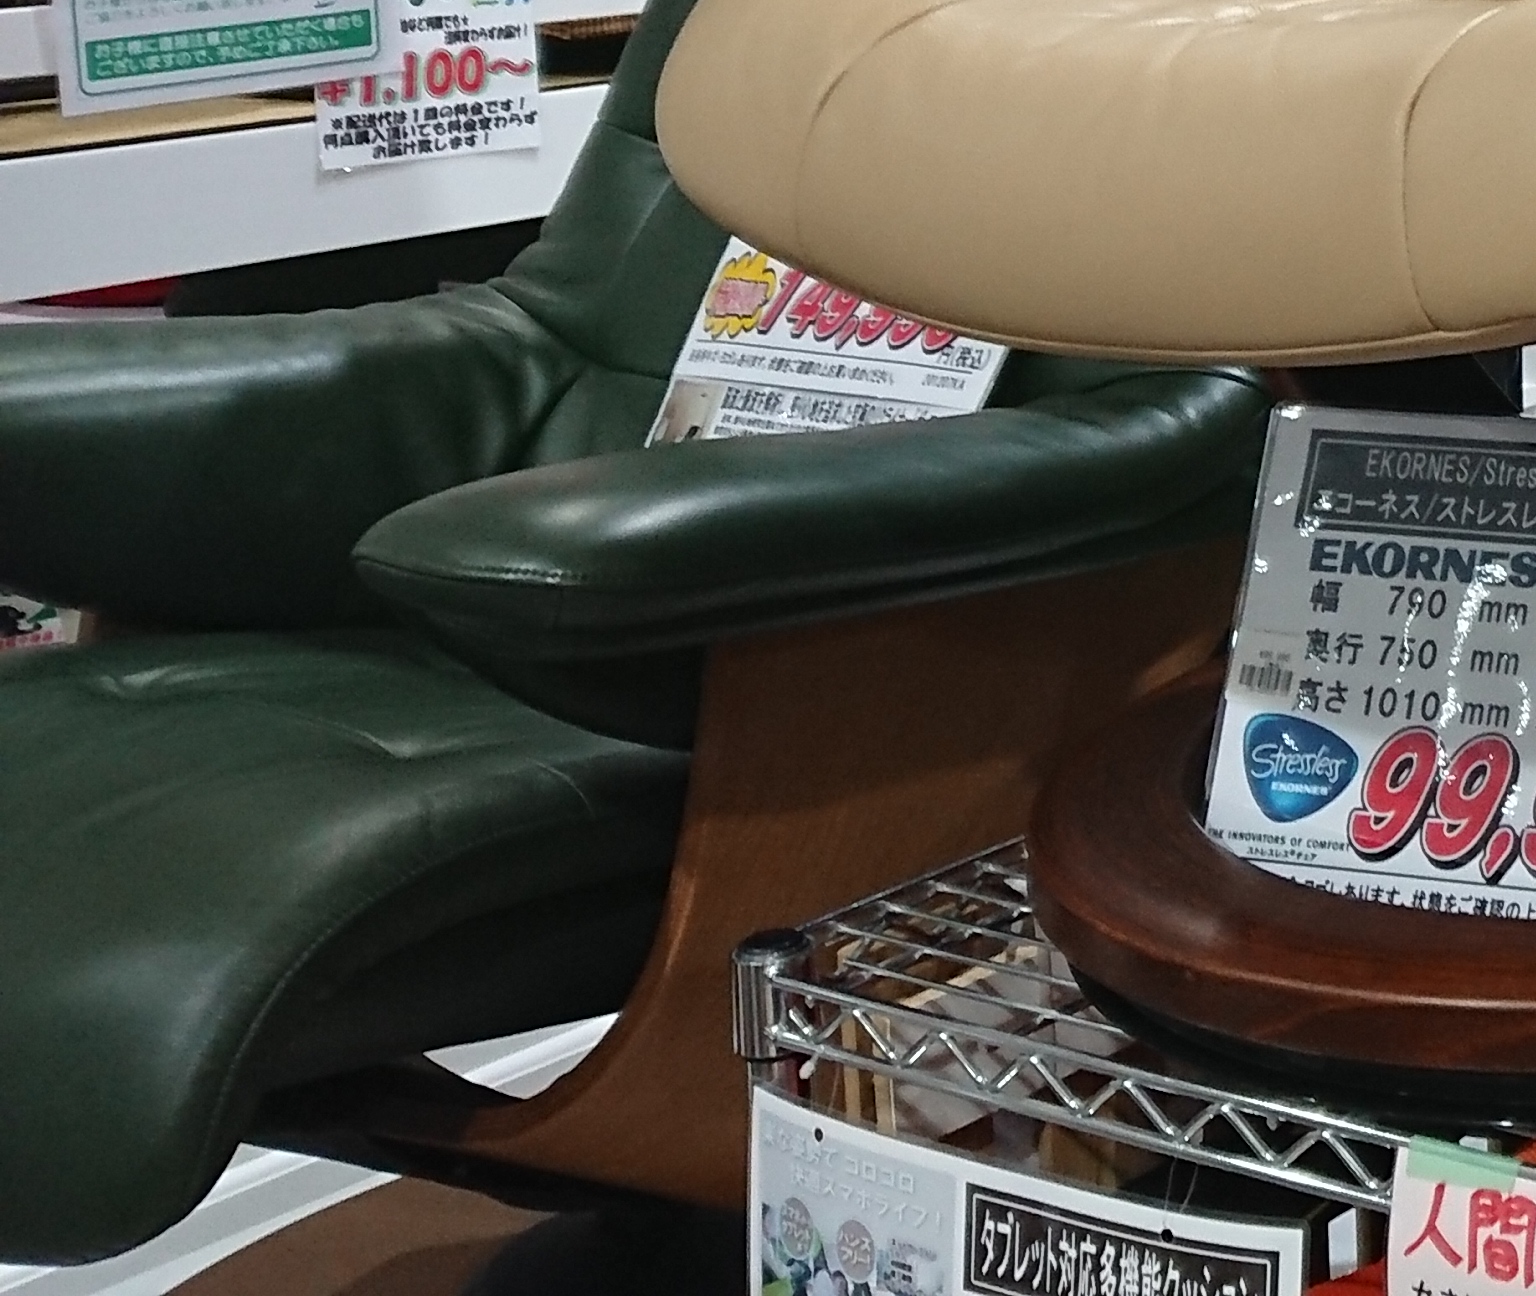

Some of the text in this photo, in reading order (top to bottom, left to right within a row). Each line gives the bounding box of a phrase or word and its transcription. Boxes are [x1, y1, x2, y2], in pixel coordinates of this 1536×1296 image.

[1309, 578, 1343, 614] 幅
[1477, 600, 1529, 626] mm
[1304, 627, 1520, 676] 奥行 750 mm
[1292, 676, 1510, 729] 高さ 1010 mm
[1251, 743, 1347, 784] Stressless
[1228, 829, 1287, 846] INNOVATORS
[1290, 836, 1303, 846] OF
[1306, 838, 1351, 853] COMFORT
